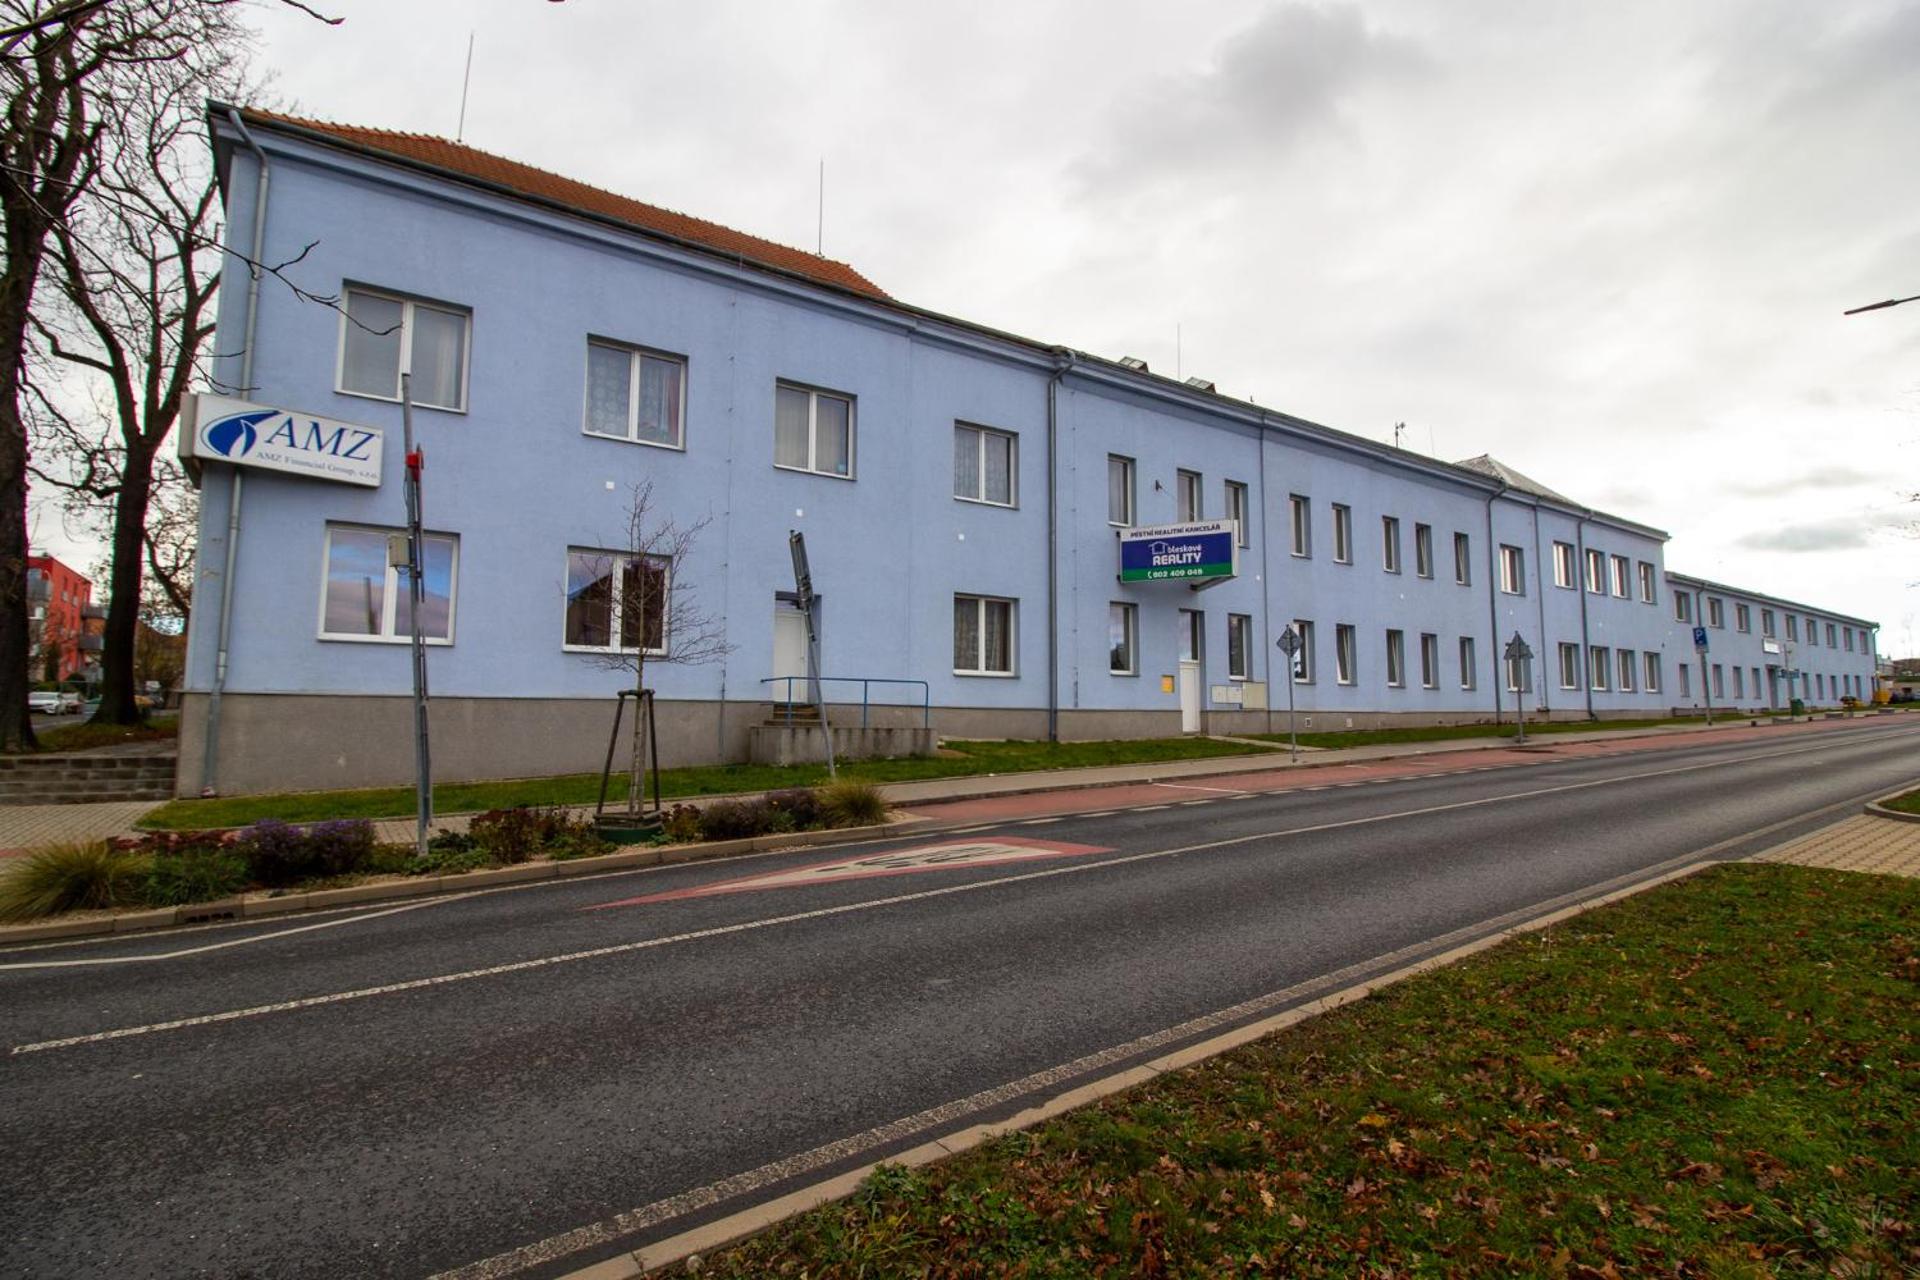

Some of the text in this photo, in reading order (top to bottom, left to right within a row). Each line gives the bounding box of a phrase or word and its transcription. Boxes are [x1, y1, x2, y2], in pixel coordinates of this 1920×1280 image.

[264, 416, 376, 461] AMZ
[256, 451, 282, 462] AMZ
[284, 456, 326, 469] Financial
[1152, 552, 1202, 566] REALITY
